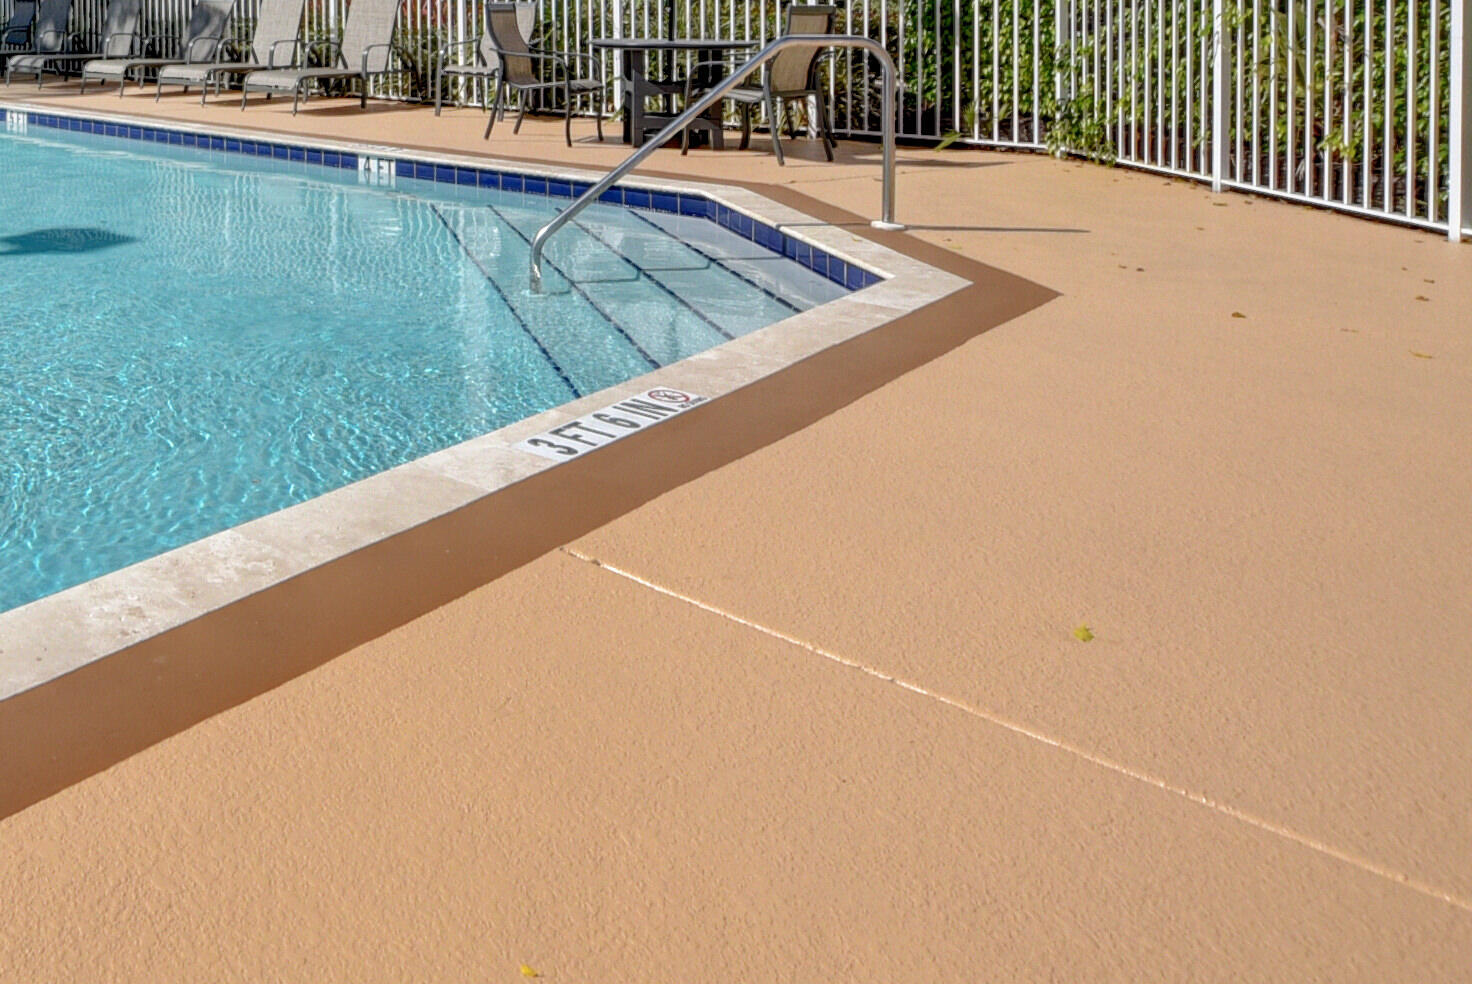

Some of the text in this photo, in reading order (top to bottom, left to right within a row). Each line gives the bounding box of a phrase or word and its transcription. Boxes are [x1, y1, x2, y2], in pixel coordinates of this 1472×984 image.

[612, 398, 680, 421] IN
[592, 413, 642, 429] 6
[548, 421, 617, 447] FT
[527, 438, 579, 456] 3
